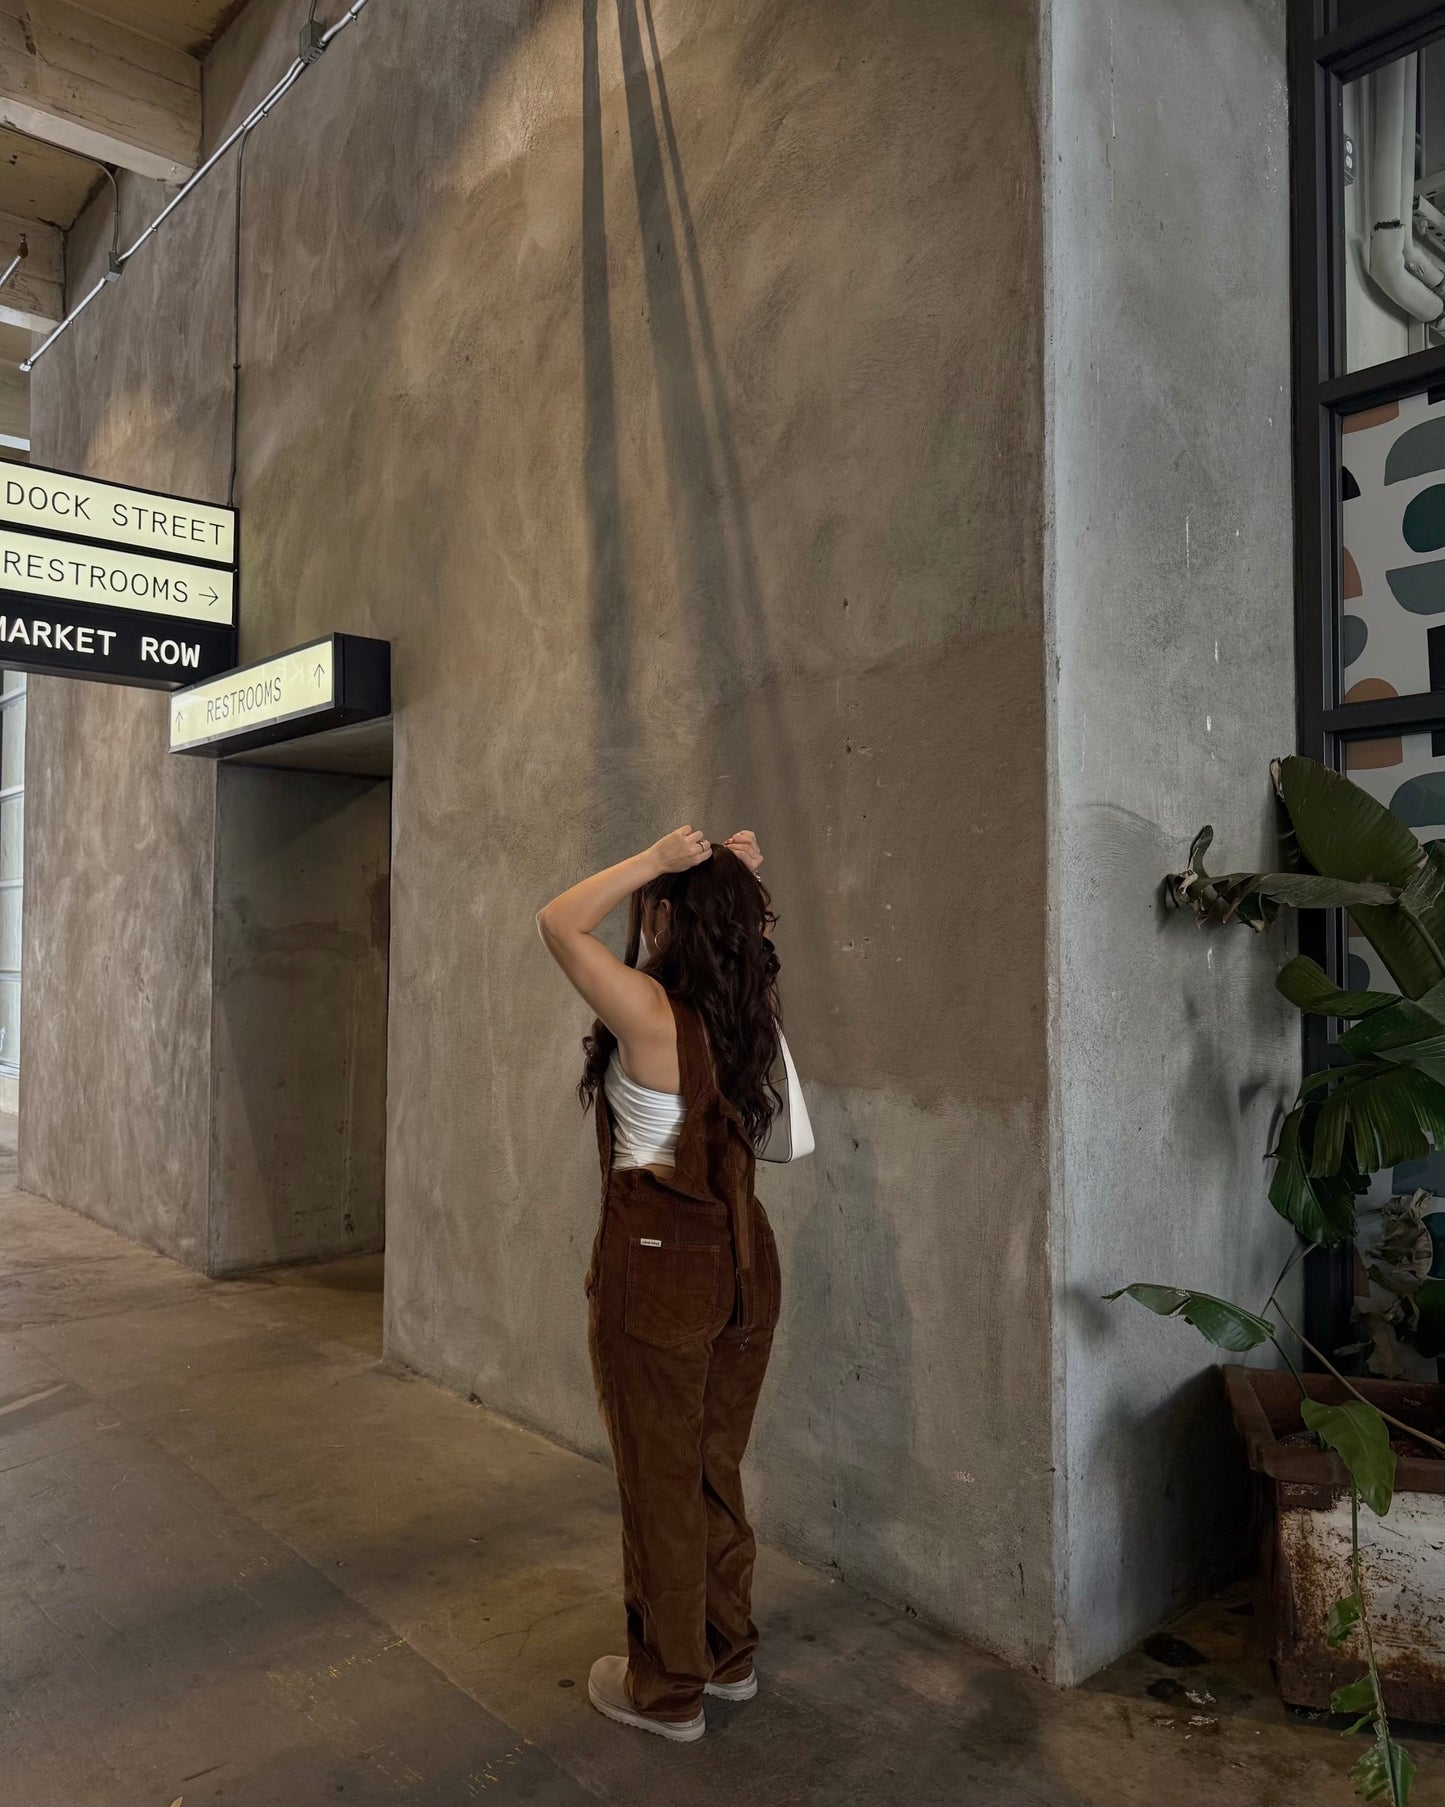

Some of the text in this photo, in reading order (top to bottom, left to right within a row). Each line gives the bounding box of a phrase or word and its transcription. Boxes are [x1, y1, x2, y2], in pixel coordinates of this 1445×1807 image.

[6, 480, 226, 546] DOCK STREET
[4, 549, 189, 603] RESTROOMS
[140, 636, 201, 669] ROW
[206, 677, 282, 724] RESTROOMS
